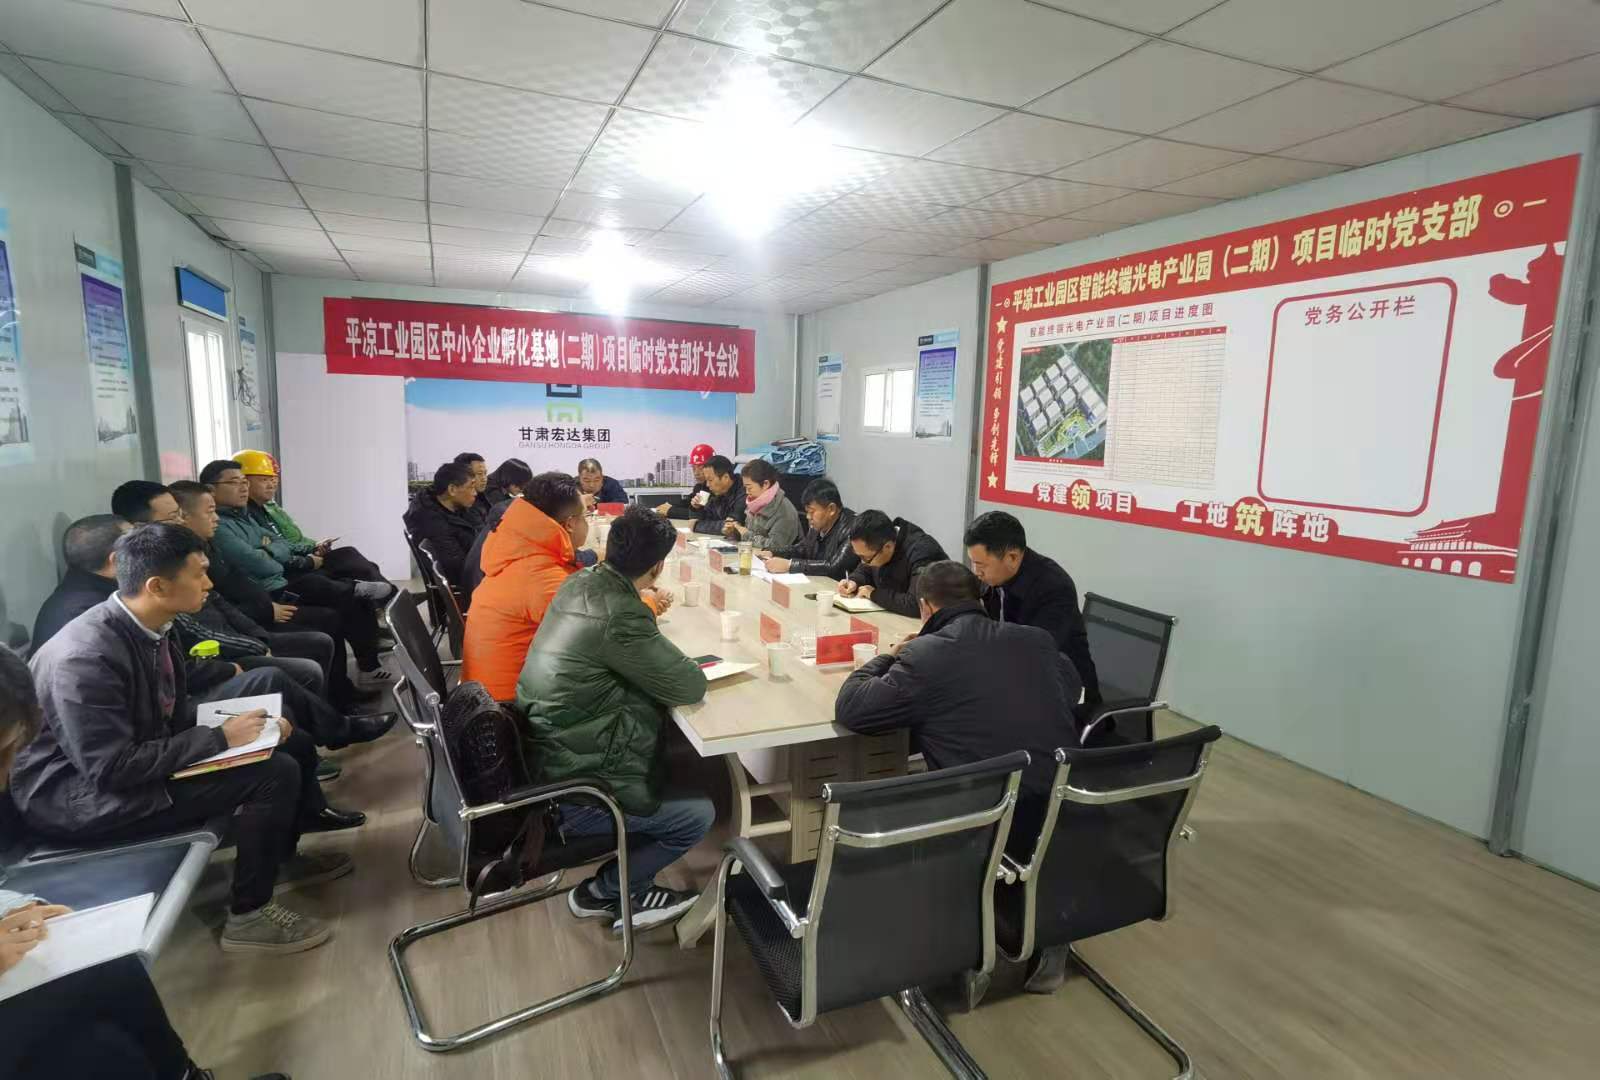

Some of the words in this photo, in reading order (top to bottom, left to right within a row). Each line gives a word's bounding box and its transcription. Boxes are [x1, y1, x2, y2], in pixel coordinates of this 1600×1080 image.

[1304, 296, 1416, 326] 党务公开栏
[518, 426, 611, 443] 甘肃宏达集团
[1036, 482, 1133, 515] 党建领项目
[1181, 499, 1330, 544] 工地筑阵地
